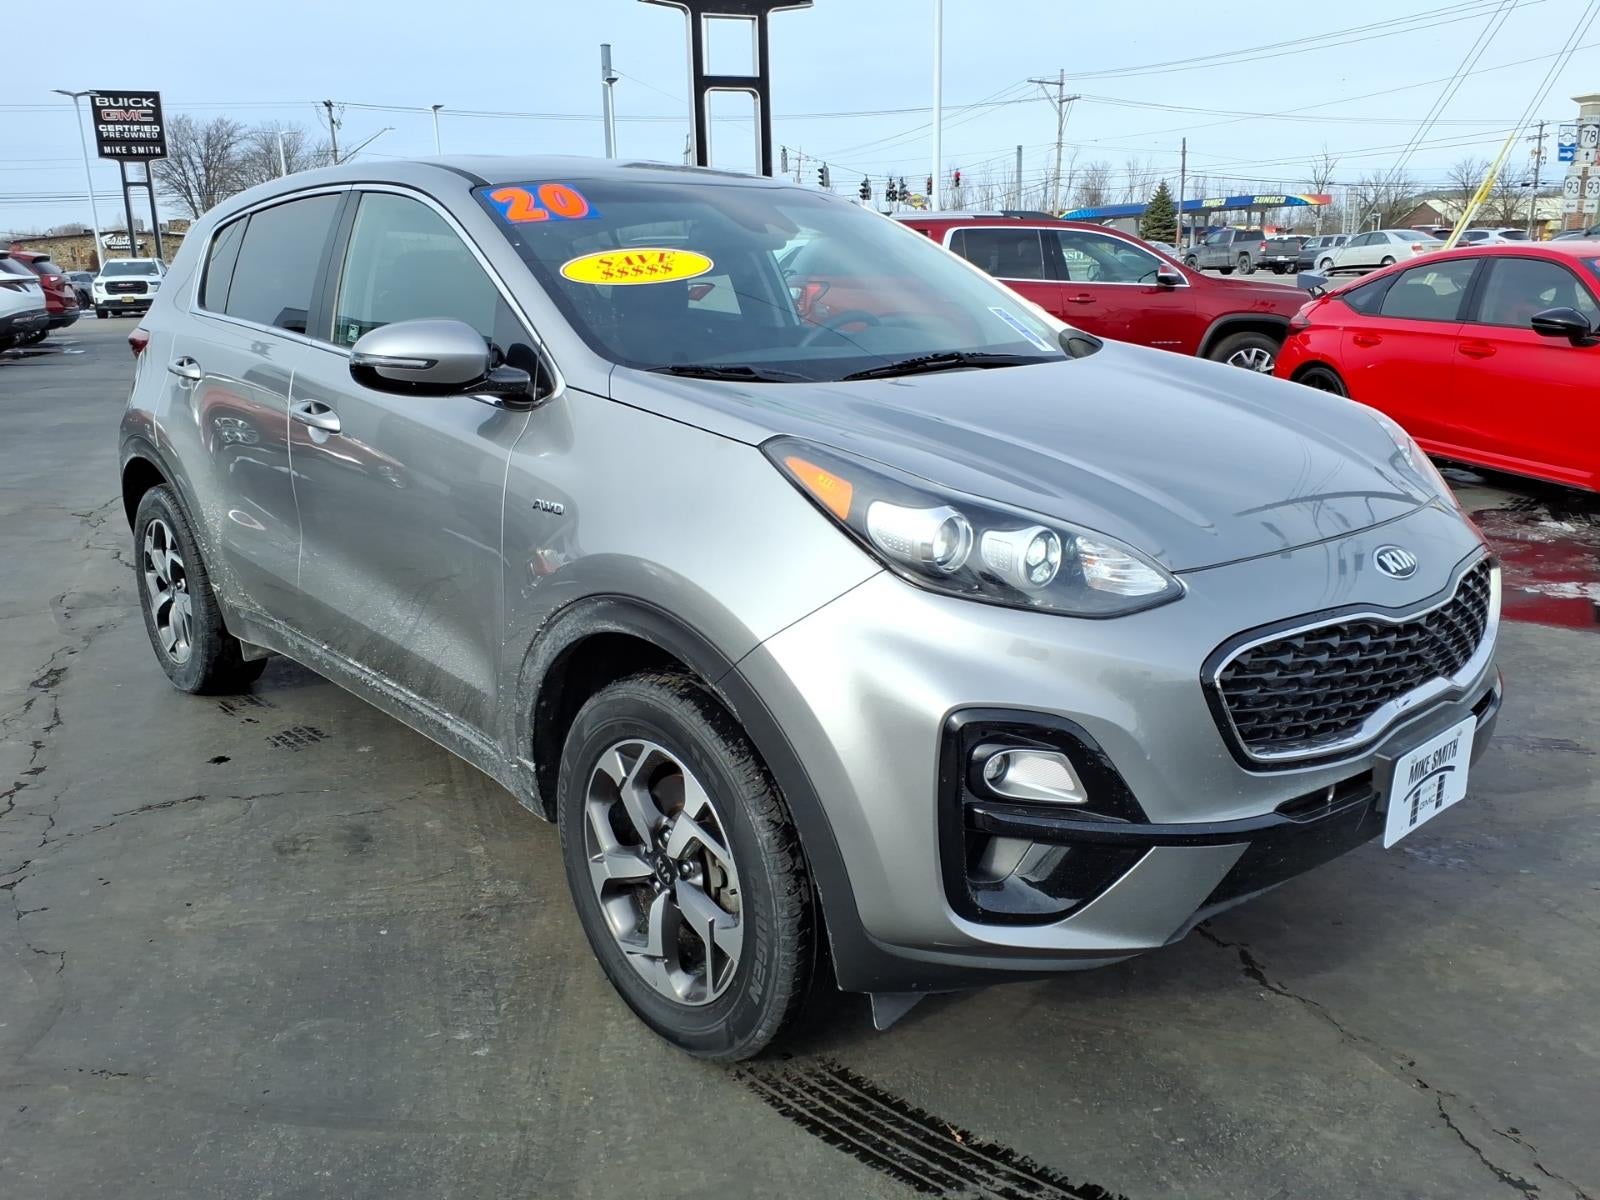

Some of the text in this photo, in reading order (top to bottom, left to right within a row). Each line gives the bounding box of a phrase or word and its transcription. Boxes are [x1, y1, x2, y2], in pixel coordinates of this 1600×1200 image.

[95, 97, 156, 107] BUICK
[101, 109, 154, 121] GMC
[1583, 130, 1597, 143] 78
[103, 146, 161, 154] MIKE SMITH
[1566, 181, 1579, 194] 93
[1587, 181, 1600, 194] 93
[490, 183, 590, 223] 20
[1253, 196, 1286, 204] SUNOCO
[597, 252, 675, 268] SAVE
[600, 262, 673, 280] $$$$$
[532, 498, 564, 515] AWD
[1379, 549, 1416, 573] KIA
[1408, 738, 1459, 786] MIKE SMITH
